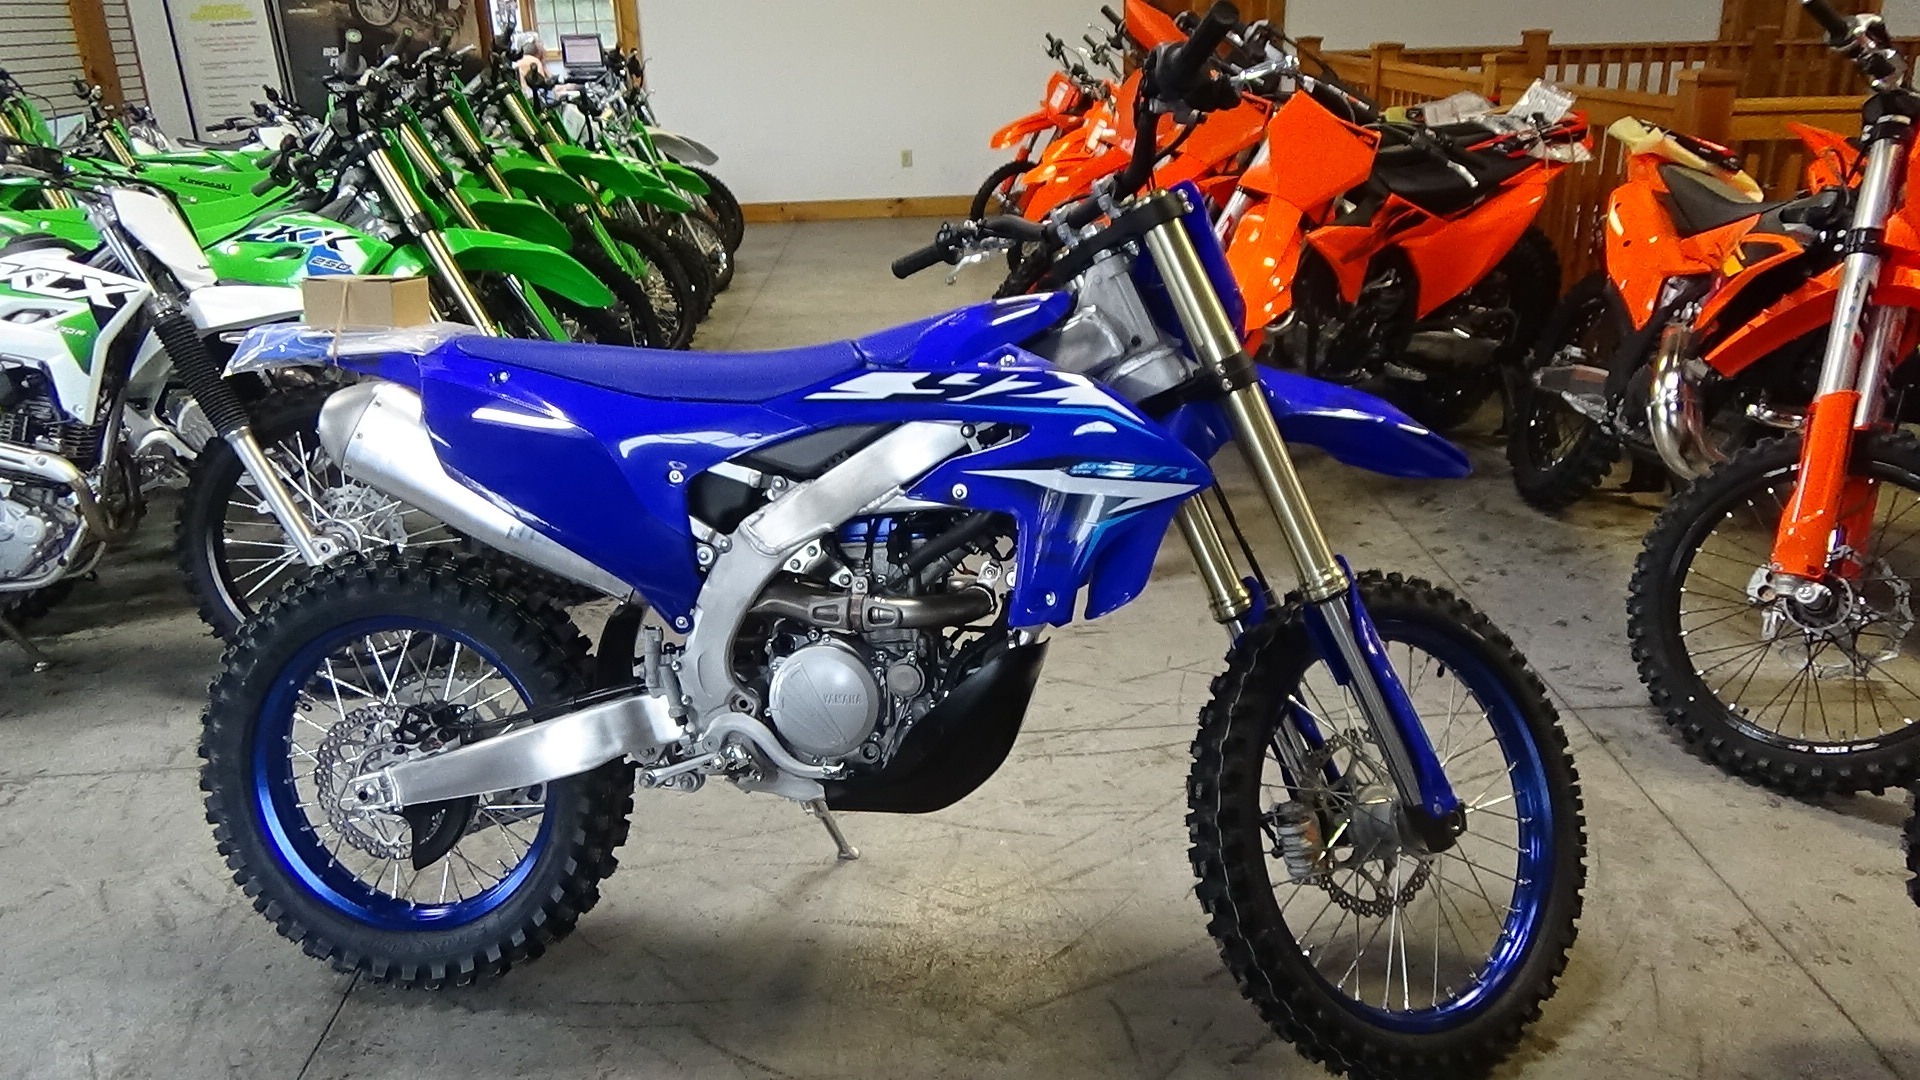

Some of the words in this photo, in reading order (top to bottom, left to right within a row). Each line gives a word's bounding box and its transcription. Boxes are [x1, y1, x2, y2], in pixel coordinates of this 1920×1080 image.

[179, 176, 232, 191] Kawasaki
[311, 256, 352, 272] 250
[823, 693, 864, 706] YAMAHA
